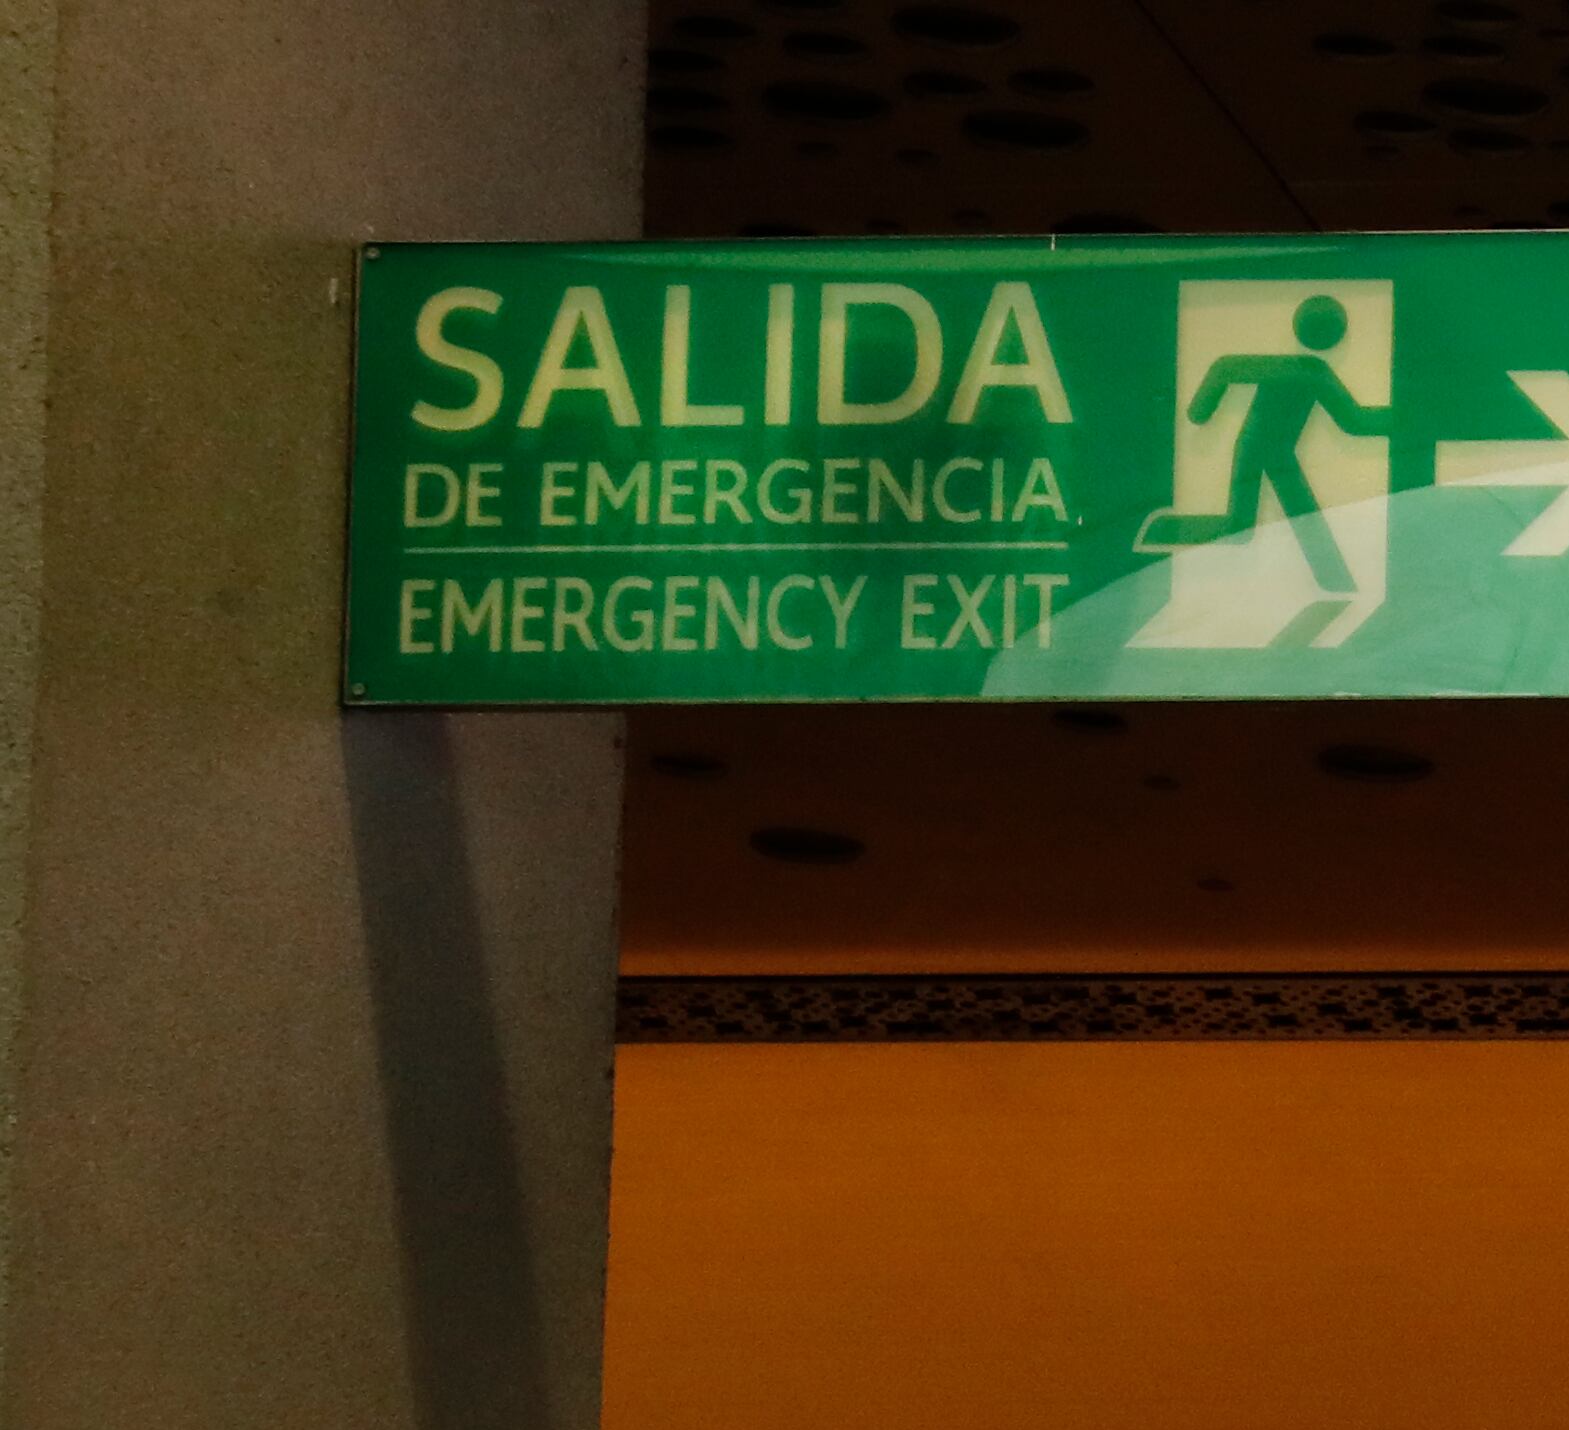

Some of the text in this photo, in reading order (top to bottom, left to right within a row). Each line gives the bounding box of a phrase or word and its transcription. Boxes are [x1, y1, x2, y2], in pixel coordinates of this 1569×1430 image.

[411, 282, 1073, 431] SALIDA
[403, 458, 1068, 527] DE EMERGENCIA
[400, 573, 1069, 653] EMERGENCY EXIT
